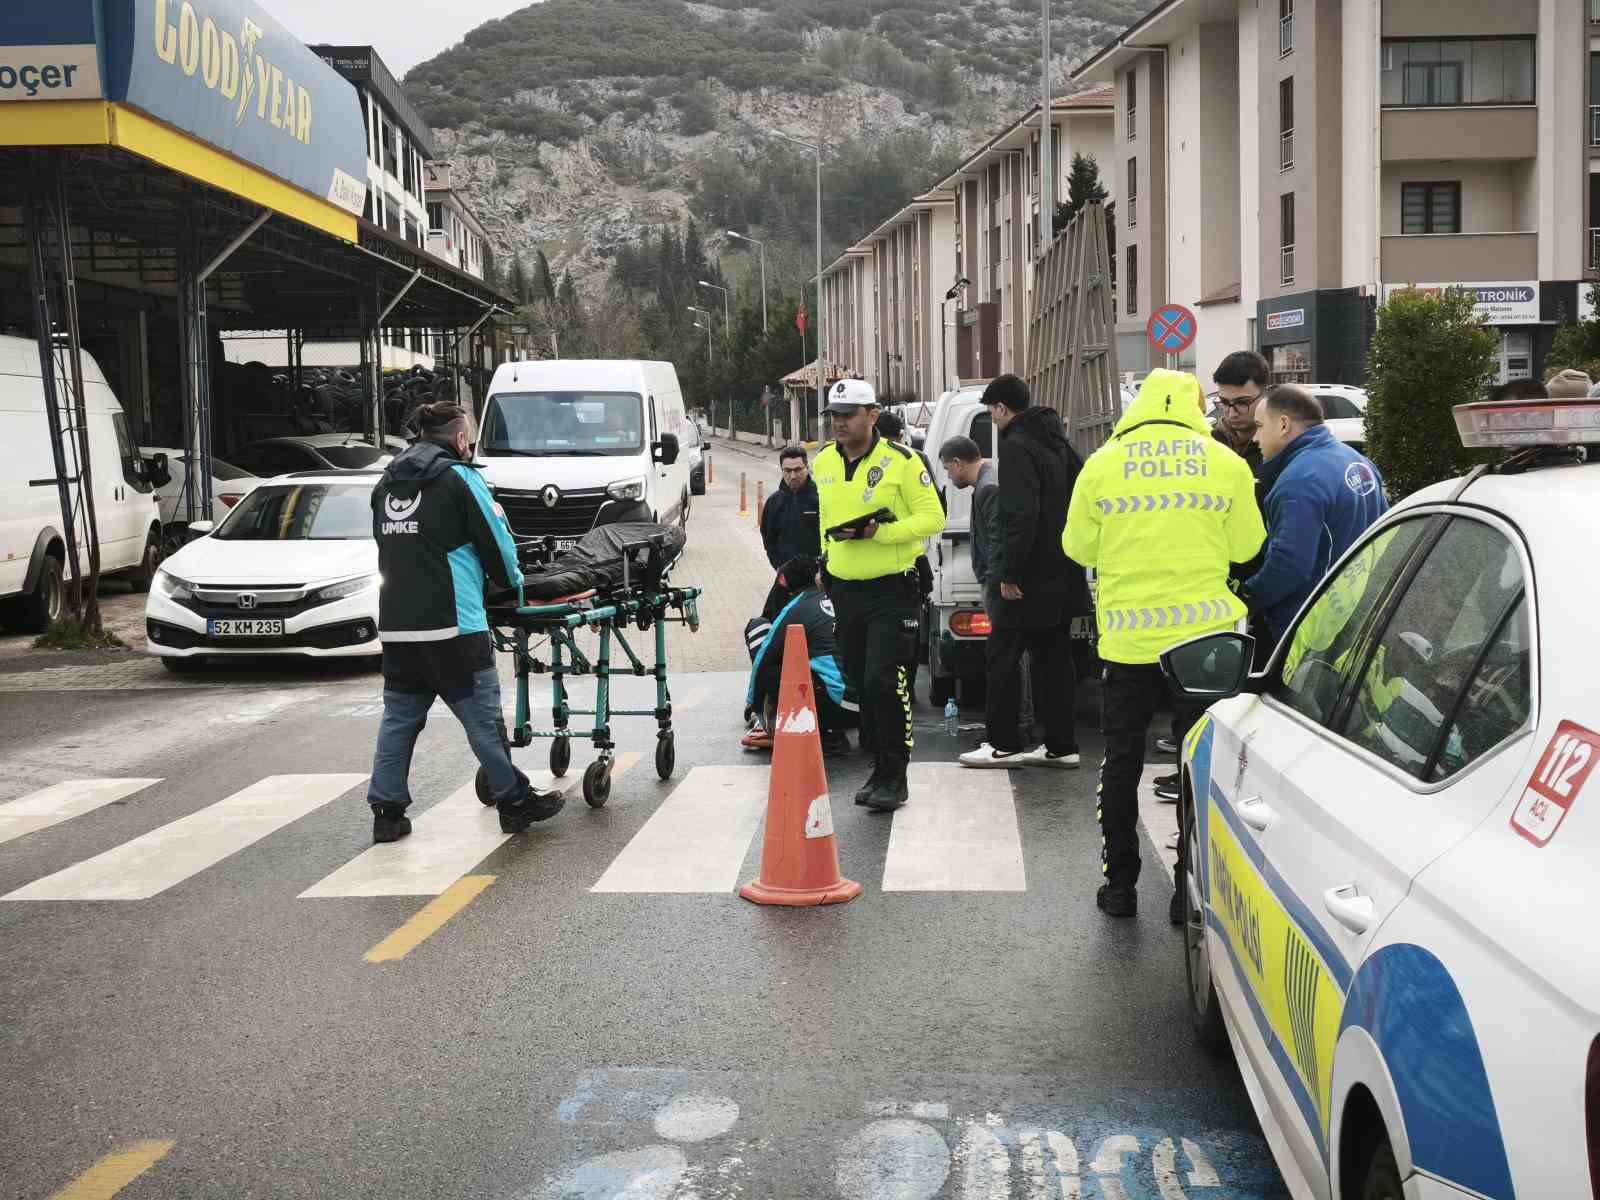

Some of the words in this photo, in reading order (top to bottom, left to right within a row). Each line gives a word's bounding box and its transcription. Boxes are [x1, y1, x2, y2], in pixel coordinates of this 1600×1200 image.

[382, 521, 418, 535] UMKE
[214, 621, 230, 634] 52
[235, 621, 252, 634] KM
[256, 621, 281, 634] 235
[1539, 733, 1592, 798] 112
